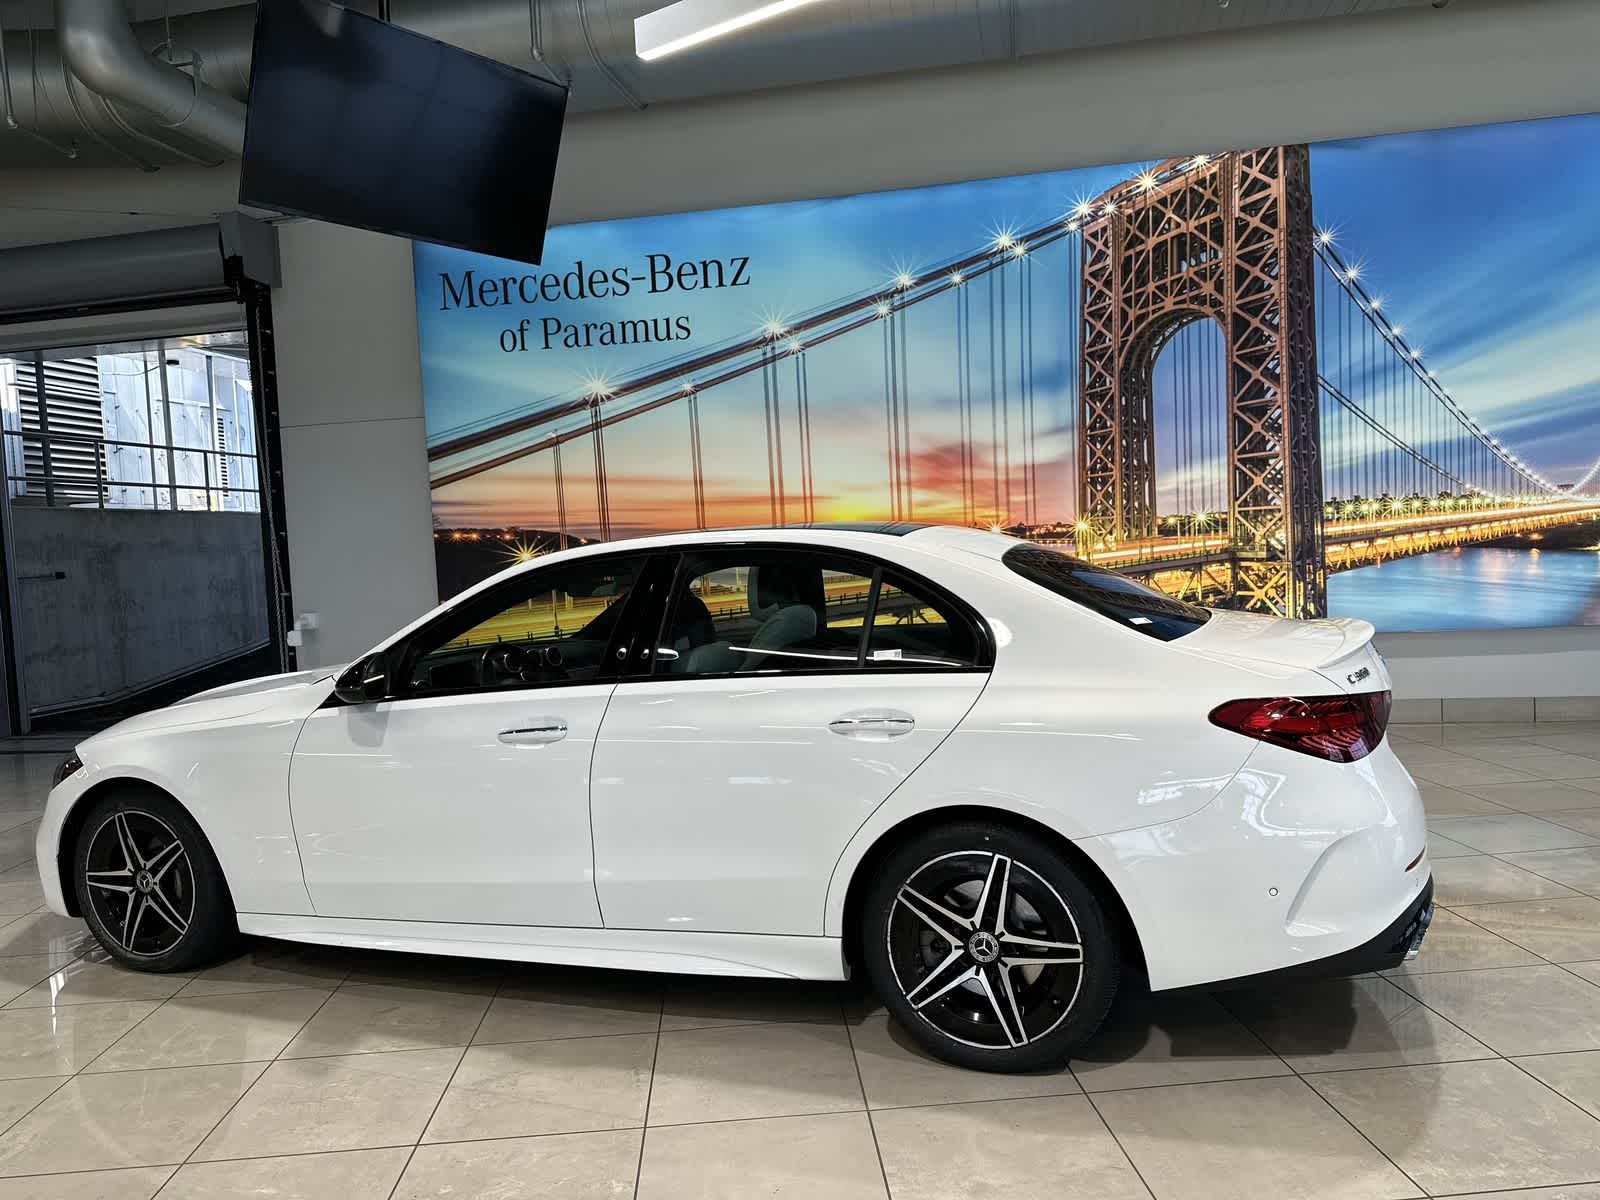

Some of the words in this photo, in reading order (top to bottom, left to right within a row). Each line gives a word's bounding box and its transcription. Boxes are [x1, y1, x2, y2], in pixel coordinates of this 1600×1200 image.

[439, 253, 750, 310] Mercedes-Benz
[500, 319, 530, 352] of
[540, 315, 691, 350] Paramus
